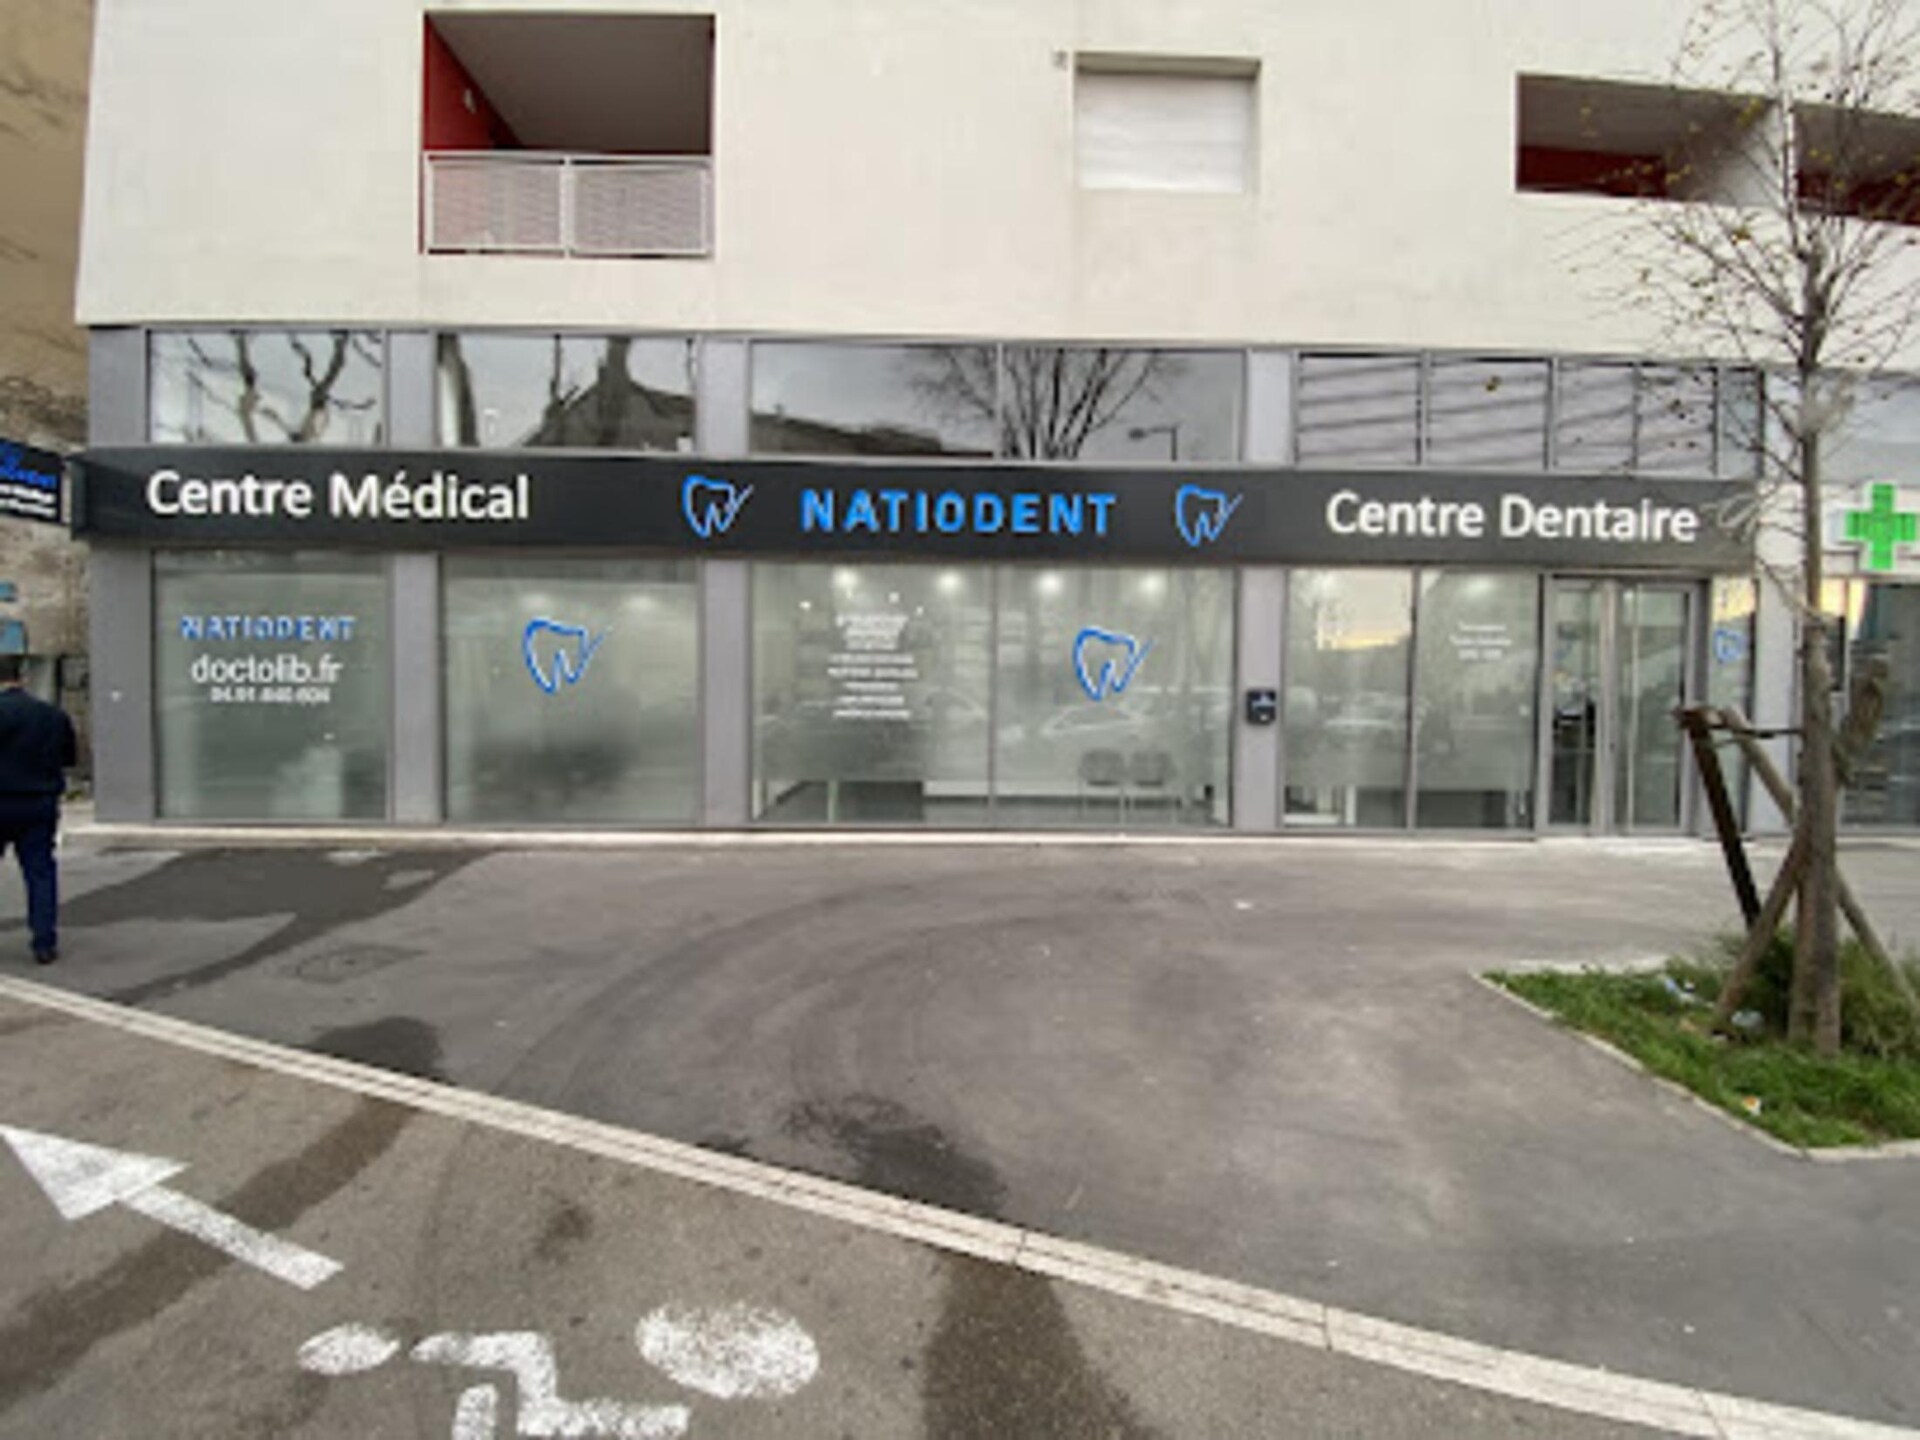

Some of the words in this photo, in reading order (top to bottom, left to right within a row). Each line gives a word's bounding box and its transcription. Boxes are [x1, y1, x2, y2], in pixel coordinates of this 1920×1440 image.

[147, 470, 313, 516] Centre
[329, 471, 529, 519] Médical
[801, 489, 1116, 535] NATIODENT
[1327, 490, 1484, 537] Centre
[1500, 494, 1698, 542] Dentaire
[181, 615, 356, 640] NATIODENT
[191, 654, 343, 683] doctolib.fr
